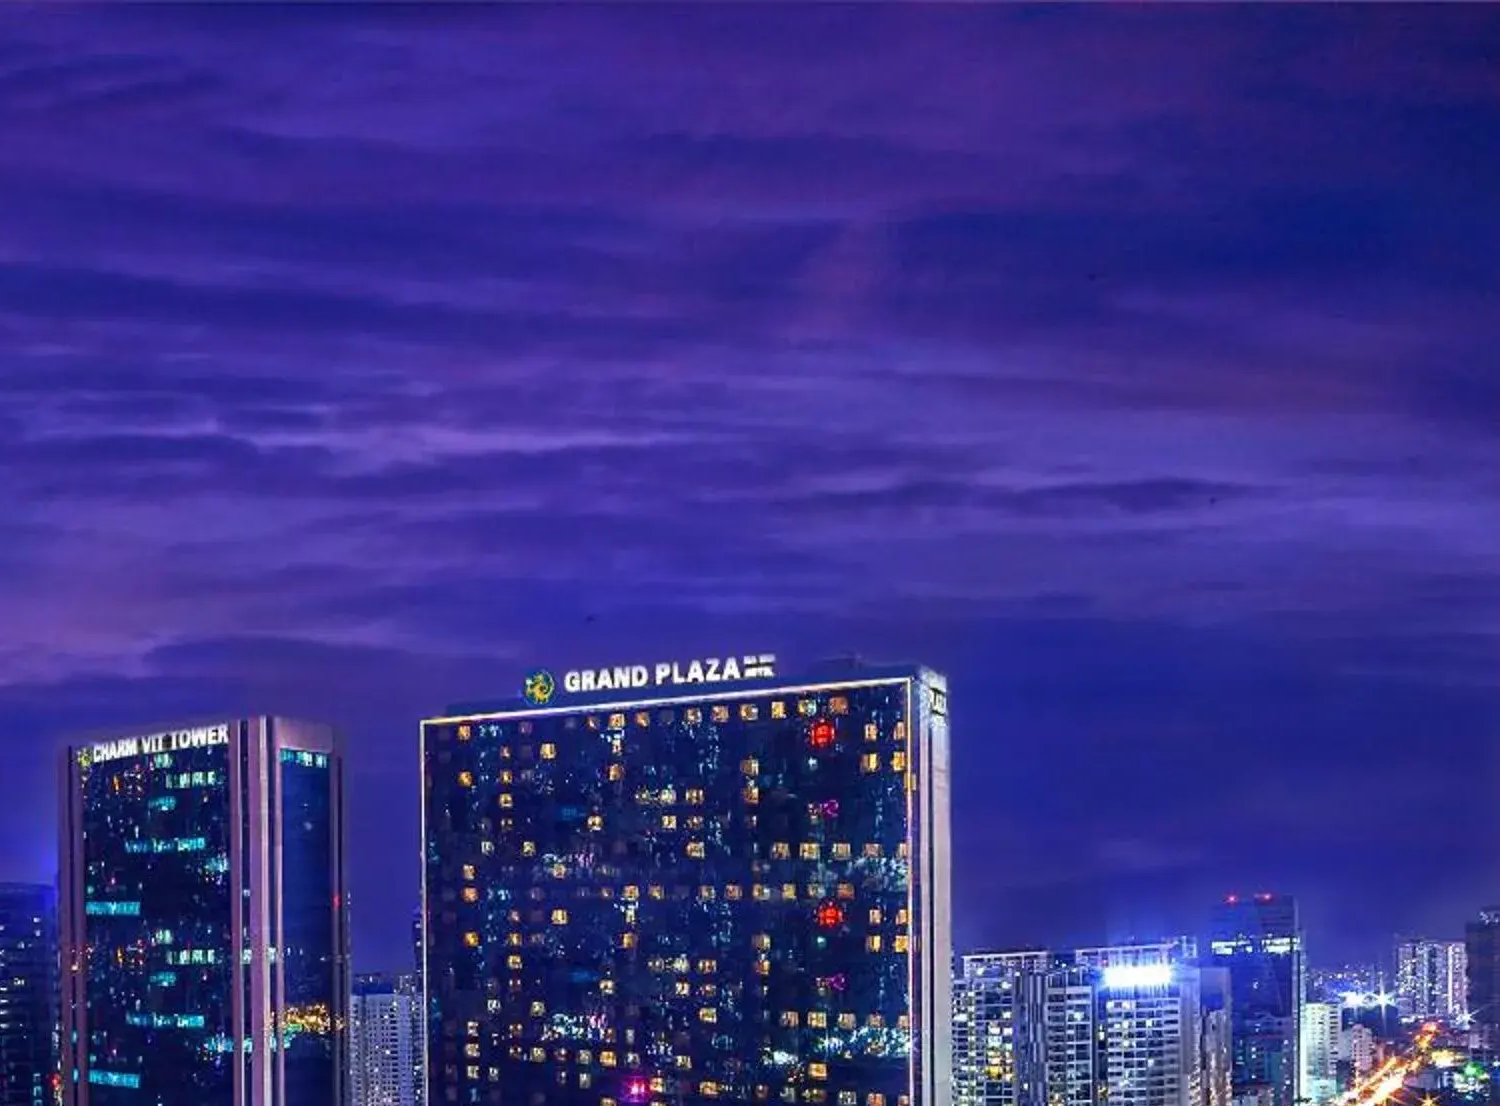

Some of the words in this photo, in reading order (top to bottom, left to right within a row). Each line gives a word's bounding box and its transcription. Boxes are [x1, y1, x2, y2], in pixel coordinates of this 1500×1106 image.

[564, 665, 648, 693] GRAND
[655, 655, 740, 685] PLAZA
[94, 736, 138, 763] CHARM
[141, 733, 167, 754] VIT
[170, 723, 229, 750] TOWER
